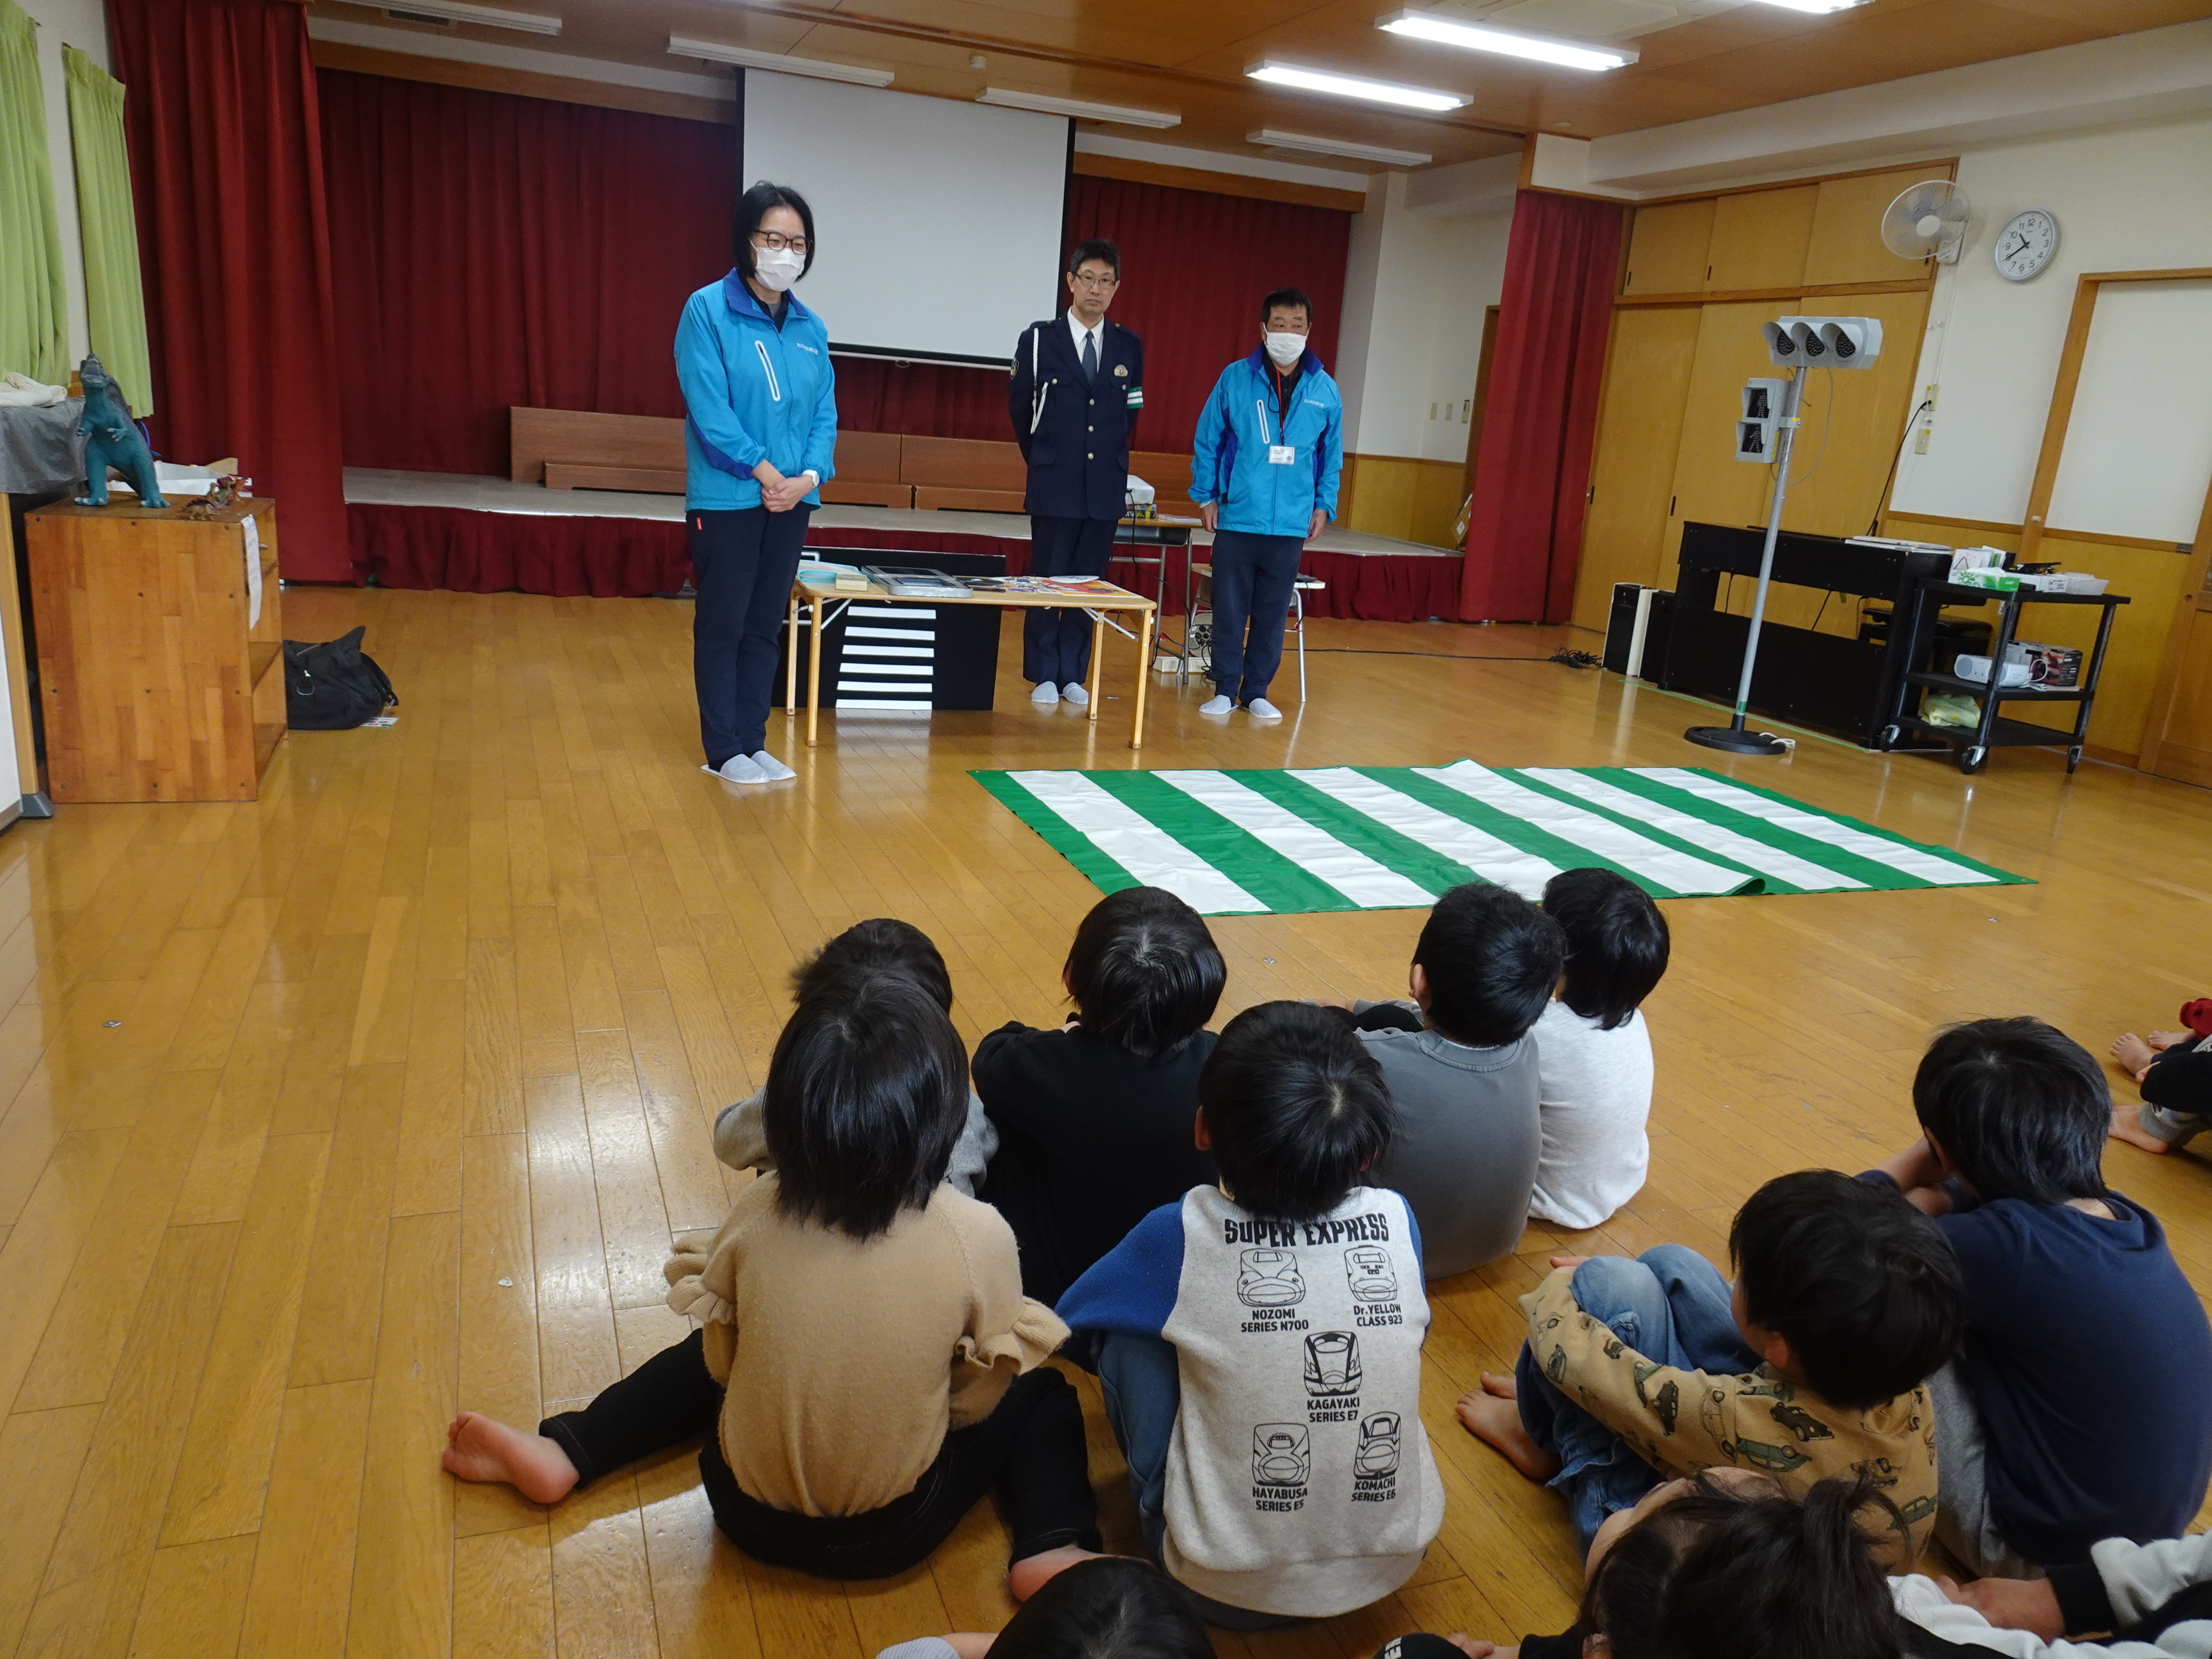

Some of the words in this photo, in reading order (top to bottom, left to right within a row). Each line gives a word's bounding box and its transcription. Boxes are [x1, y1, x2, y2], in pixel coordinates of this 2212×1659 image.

[2043, 239, 2049, 248] 3
[1225, 1218, 1296, 1247] SUPER
[1302, 1213, 1389, 1245] EXPRESS
[1252, 1308, 1295, 1320] NOZOMI
[1354, 1303, 1401, 1315] Dr.YELLOW
[1241, 1322, 1277, 1332] SERIES
[1280, 1320, 1309, 1331] N700
[1357, 1316, 1386, 1326] CLASS
[1388, 1315, 1402, 1324] 923
[1307, 1397, 1359, 1410] KAGAYAKI
[1309, 1411, 1345, 1423] SERIES
[1348, 1410, 1358, 1420] E7
[1355, 1476, 1395, 1490] KOMACHI
[1252, 1486, 1308, 1499] HAYABUSA
[1351, 1492, 1385, 1502] SERIES
[1386, 1489, 1395, 1499] E6
[1256, 1500, 1291, 1512] SERIES
[1293, 1499, 1304, 1509] E5
